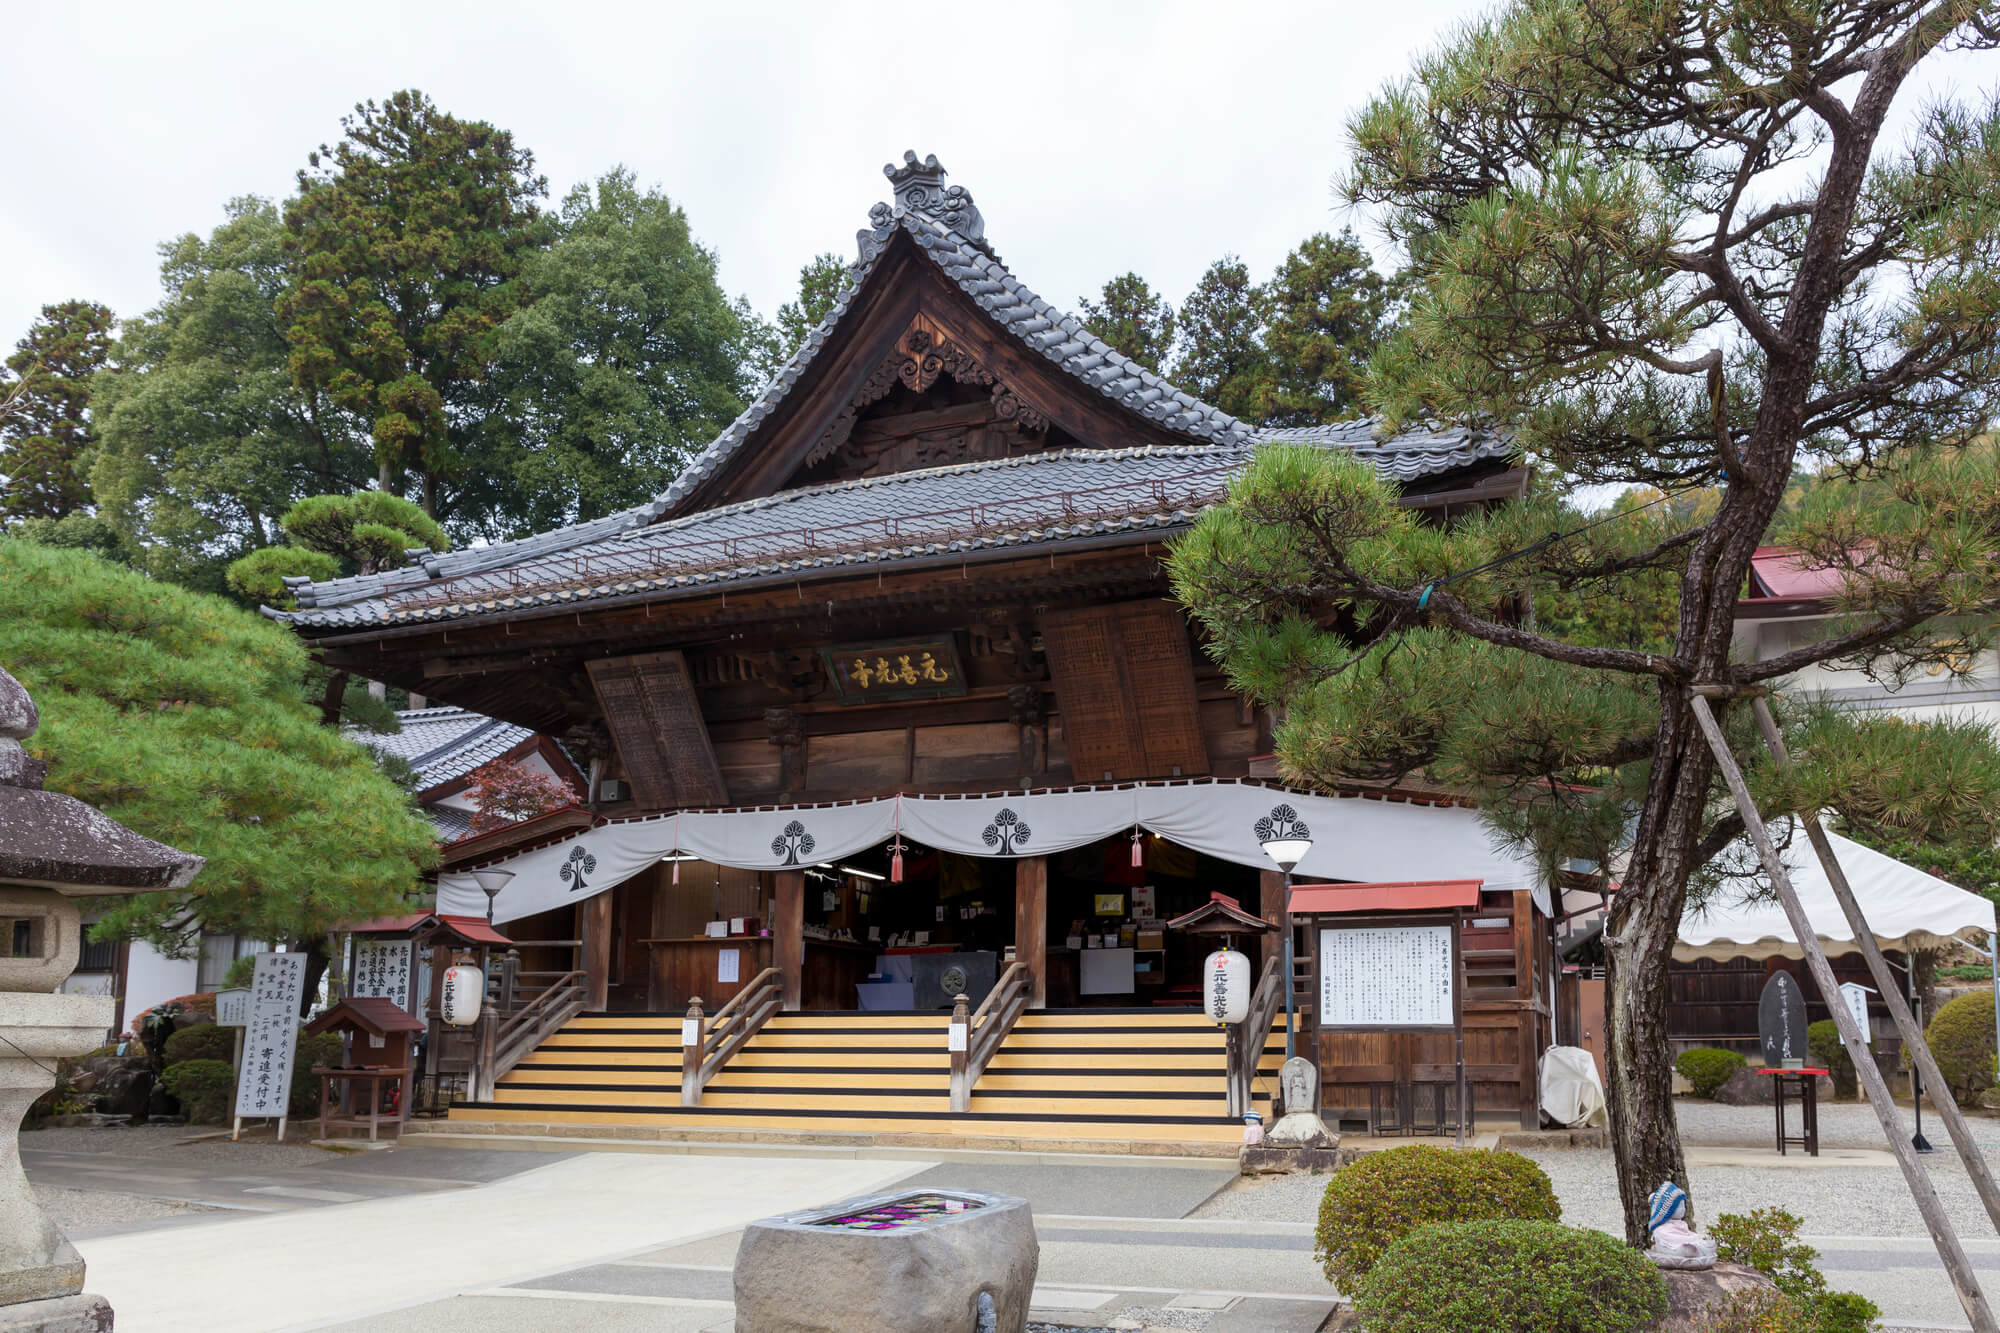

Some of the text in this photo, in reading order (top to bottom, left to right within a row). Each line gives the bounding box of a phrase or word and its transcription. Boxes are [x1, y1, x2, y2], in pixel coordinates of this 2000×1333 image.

[444, 981, 455, 1021] 元善光寺
[1213, 969, 1228, 1018] 元善光寺
[255, 1047, 274, 1111] 寄進受付中
